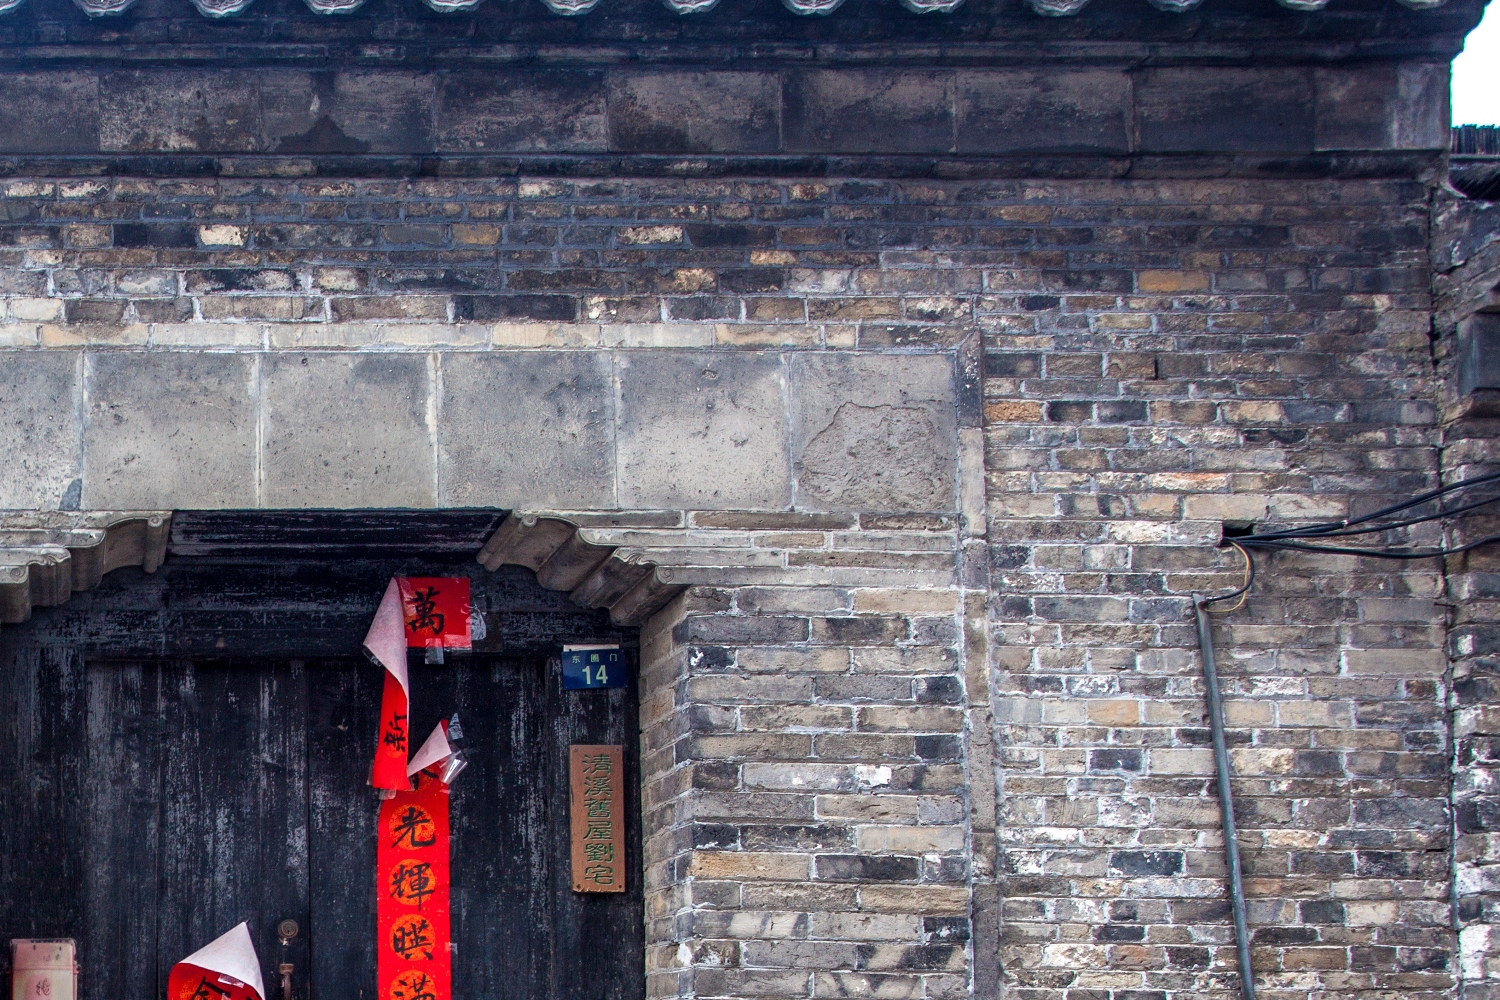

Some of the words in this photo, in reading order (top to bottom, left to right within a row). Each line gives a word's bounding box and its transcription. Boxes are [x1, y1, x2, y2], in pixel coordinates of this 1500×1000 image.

[407, 586, 445, 635] 萬
[572, 653, 618, 664] 东圈门
[582, 664, 609, 685] 14
